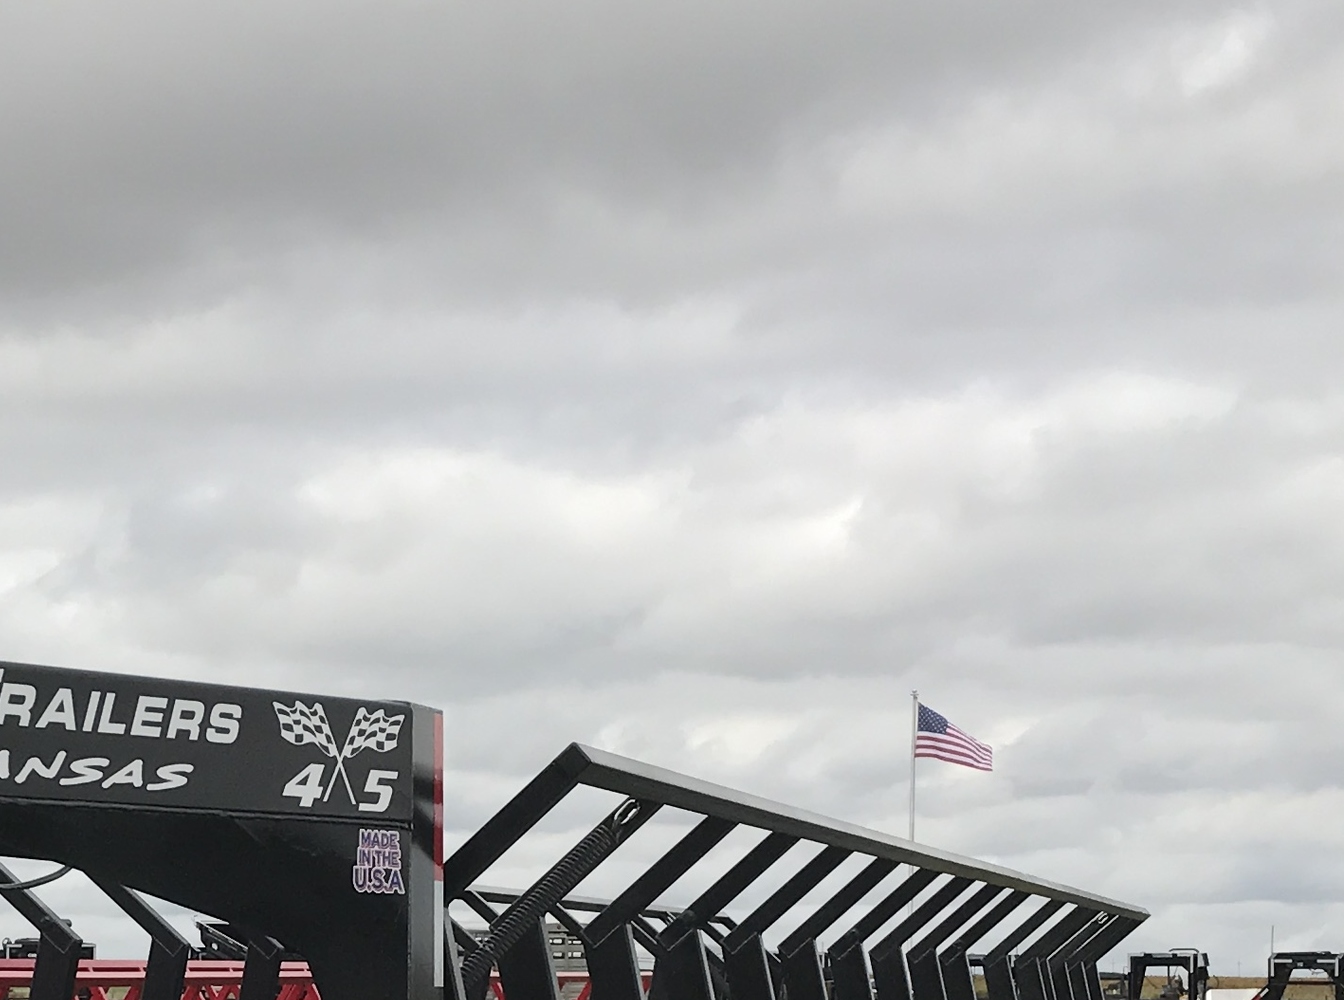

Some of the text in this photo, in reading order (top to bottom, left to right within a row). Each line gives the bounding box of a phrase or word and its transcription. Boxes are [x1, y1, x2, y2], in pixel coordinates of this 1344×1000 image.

[359, 829, 400, 850] MADE
[357, 849, 402, 869] IN THE
